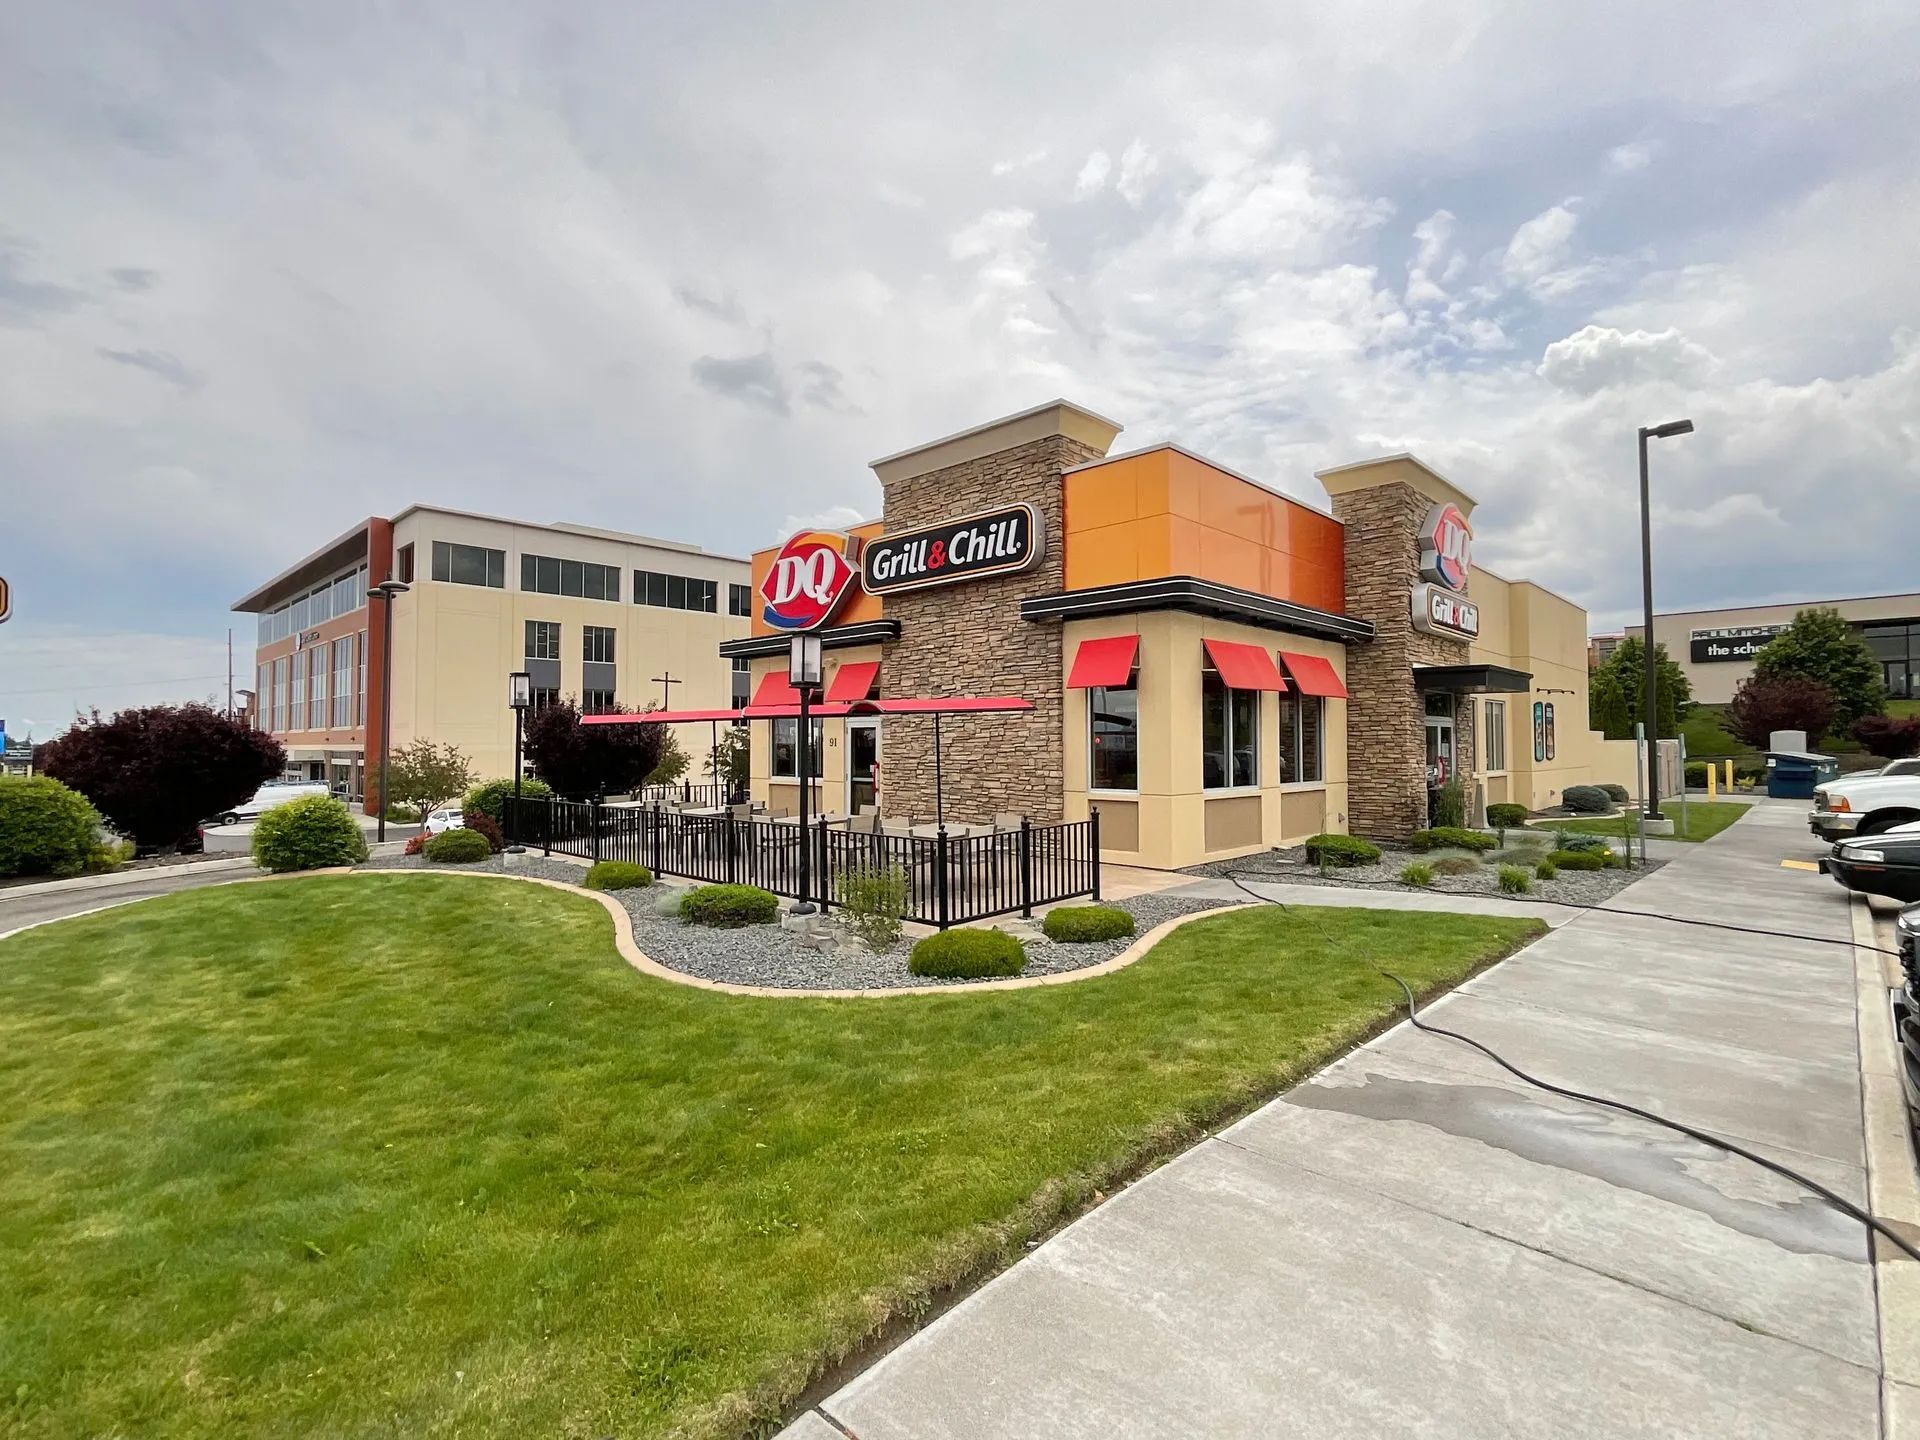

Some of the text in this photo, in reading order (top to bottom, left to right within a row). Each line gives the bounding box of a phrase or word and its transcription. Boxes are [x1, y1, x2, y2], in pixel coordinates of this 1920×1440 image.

[772, 548, 835, 605] DQ
[1708, 643, 1730, 656] the
[829, 737, 838, 747] 91
